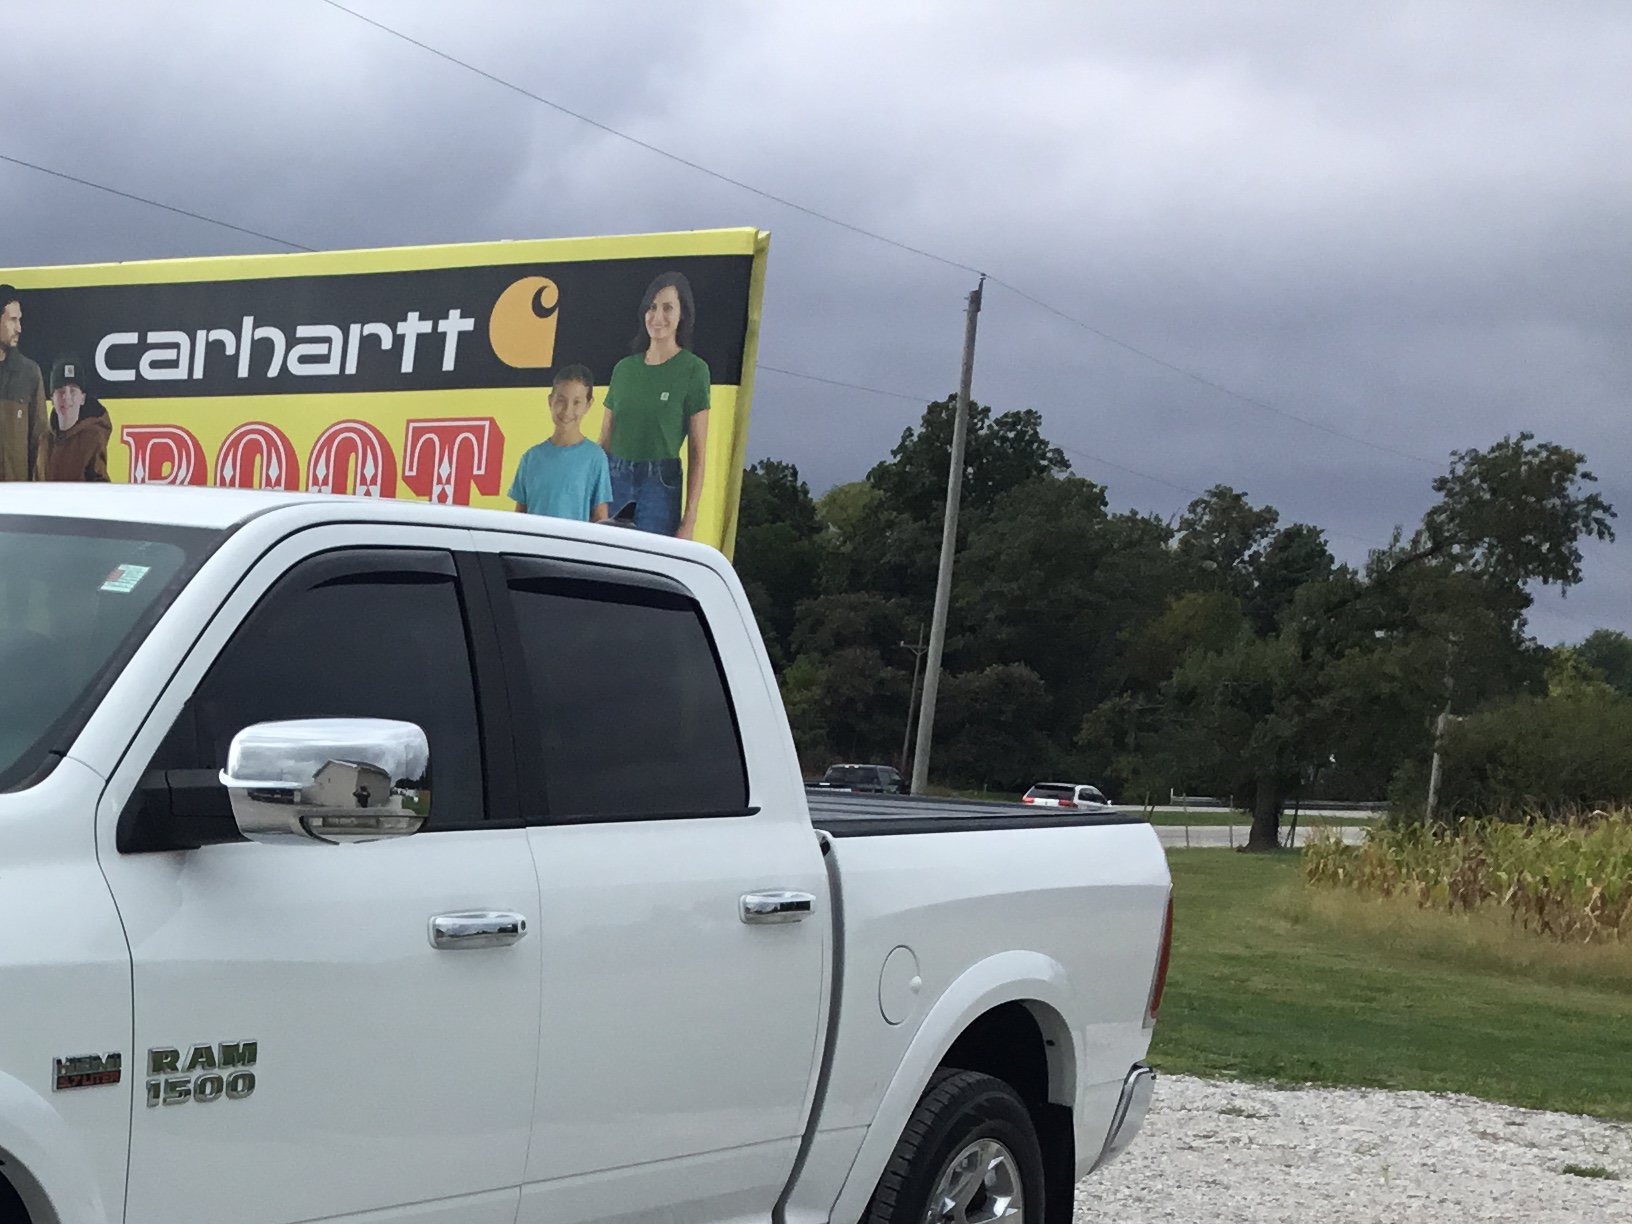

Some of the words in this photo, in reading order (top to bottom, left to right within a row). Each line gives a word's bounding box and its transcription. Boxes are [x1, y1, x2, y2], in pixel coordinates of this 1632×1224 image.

[95, 309, 475, 381] carhartt
[147, 1039, 257, 1077] RAM
[146, 1070, 255, 1108] 1500
